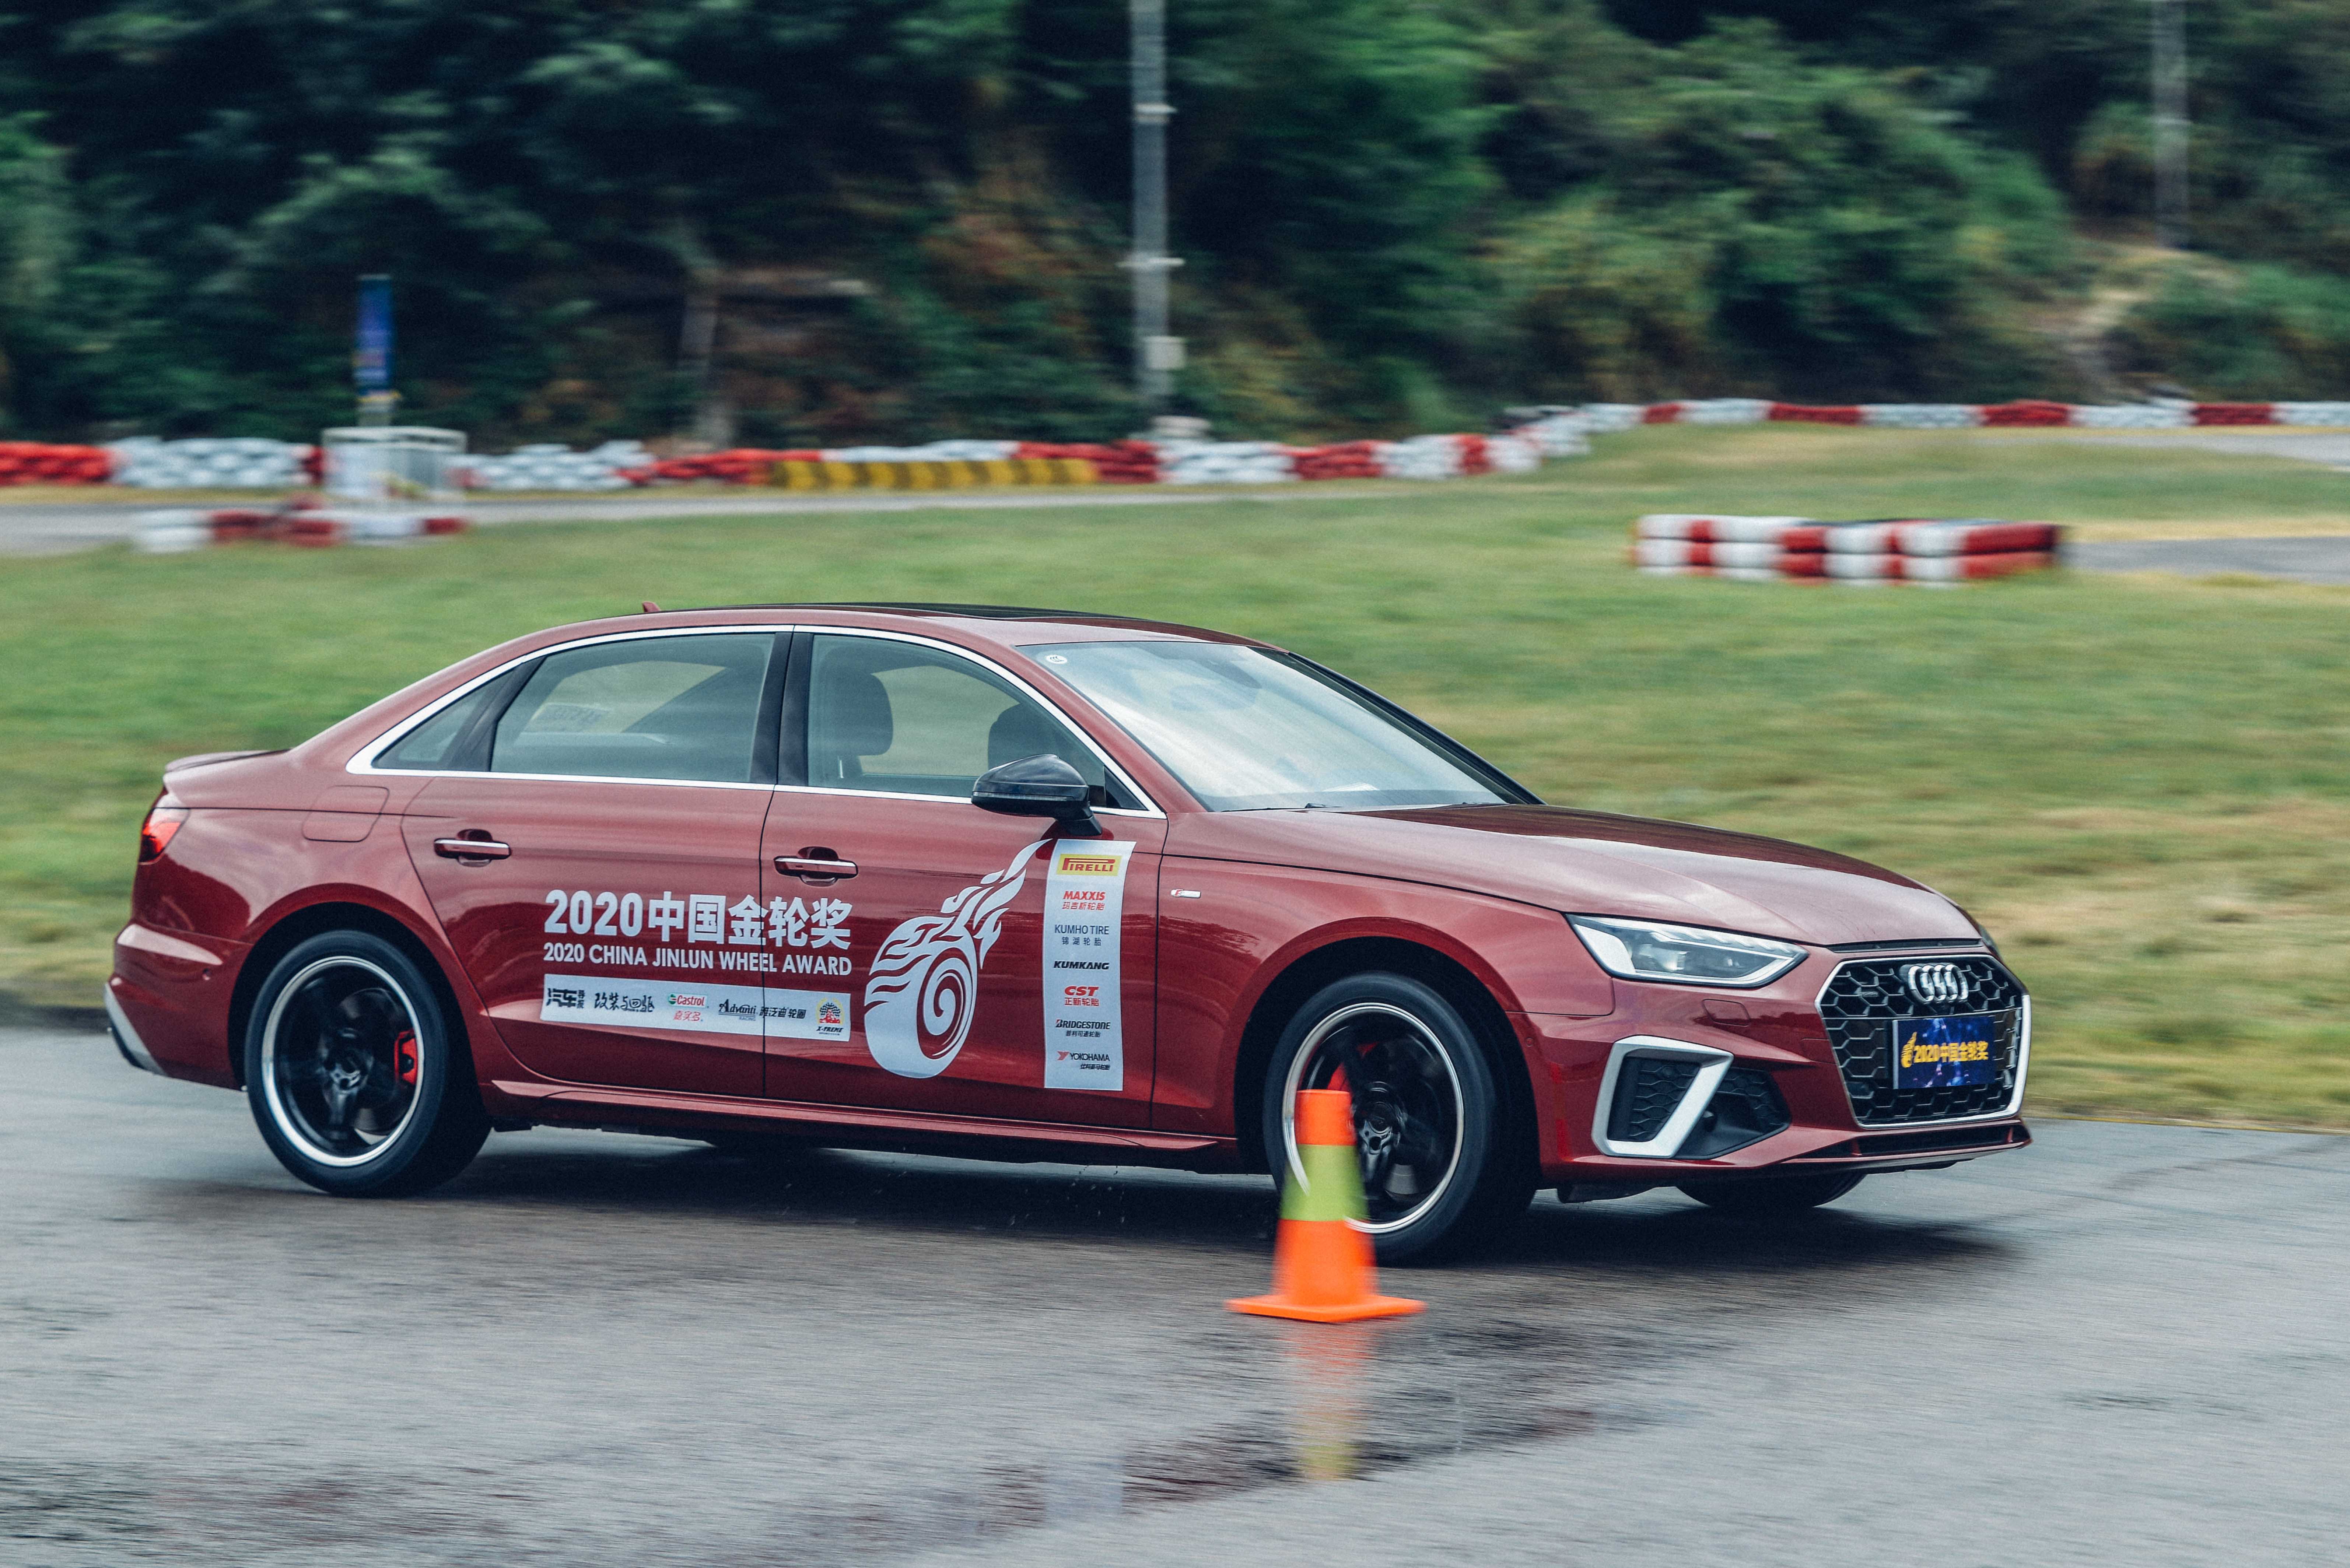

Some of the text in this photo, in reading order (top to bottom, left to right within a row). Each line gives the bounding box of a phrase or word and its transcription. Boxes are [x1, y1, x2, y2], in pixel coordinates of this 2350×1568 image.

[1062, 858, 1116, 871] PIRELLI
[1063, 891, 1105, 901] MAXXIS
[1062, 902, 1105, 911] 玛吉斯轮胎
[1055, 925, 1110, 935] KUMHO TIRE
[543, 942, 852, 976] 2020 CHINA JINLUN WHEEL AWARD
[1054, 961, 1110, 969] KUMKANG
[1065, 986, 1099, 996] CST
[677, 995, 705, 1006] Castrol
[1064, 997, 1099, 1006] 正新轮胎
[719, 999, 757, 1014] Advanti
[1055, 1019, 1111, 1029] BRIDGESTONE
[1070, 1052, 1110, 1062] YOKOHAMA
